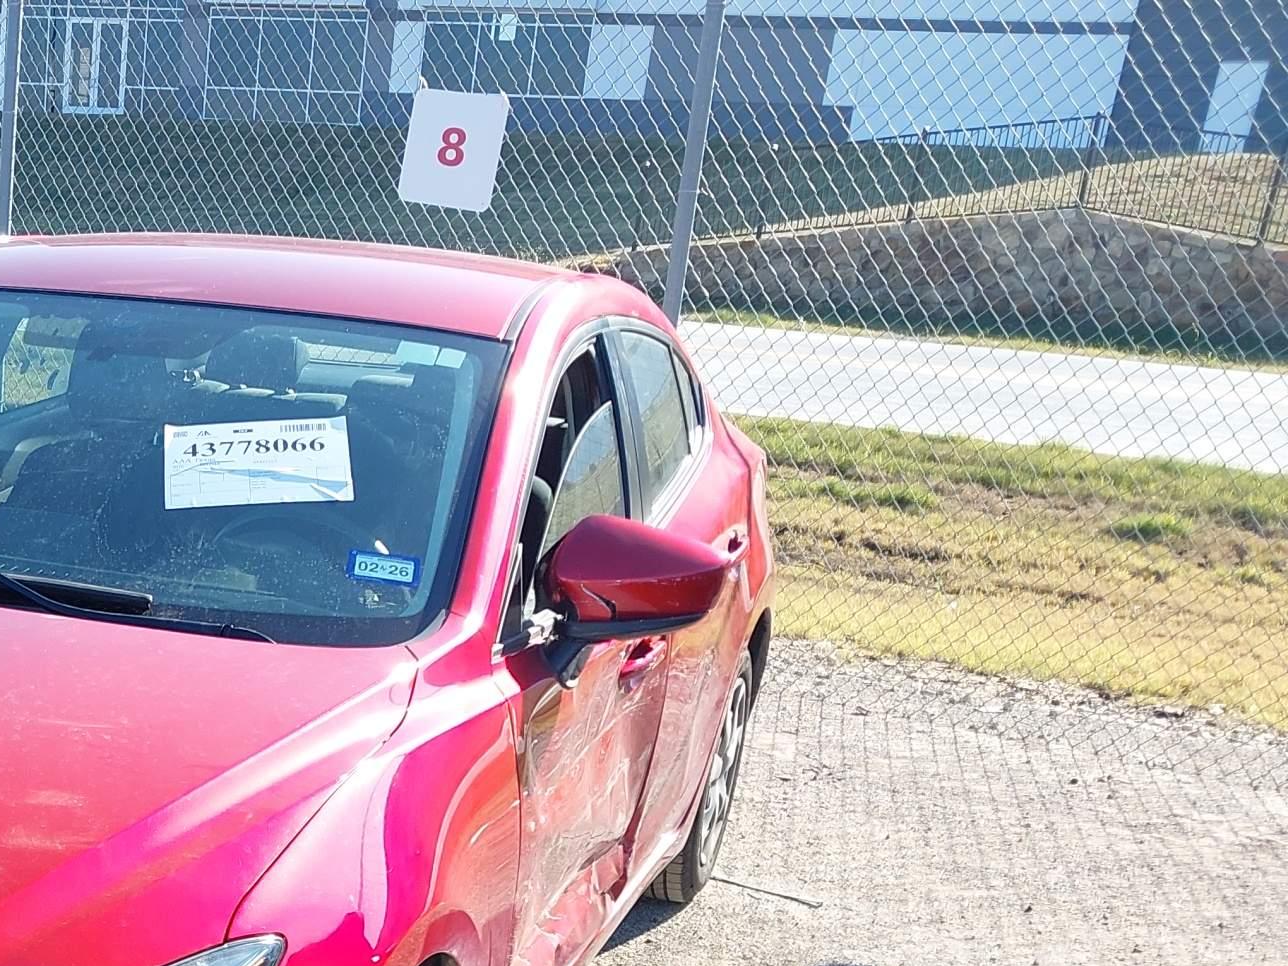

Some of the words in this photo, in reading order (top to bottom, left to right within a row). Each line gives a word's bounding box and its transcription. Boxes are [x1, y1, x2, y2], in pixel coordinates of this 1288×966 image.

[437, 127, 466, 167] 8
[183, 436, 325, 457] 43778066
[358, 561, 379, 573] 02
[388, 565, 409, 577] 26
